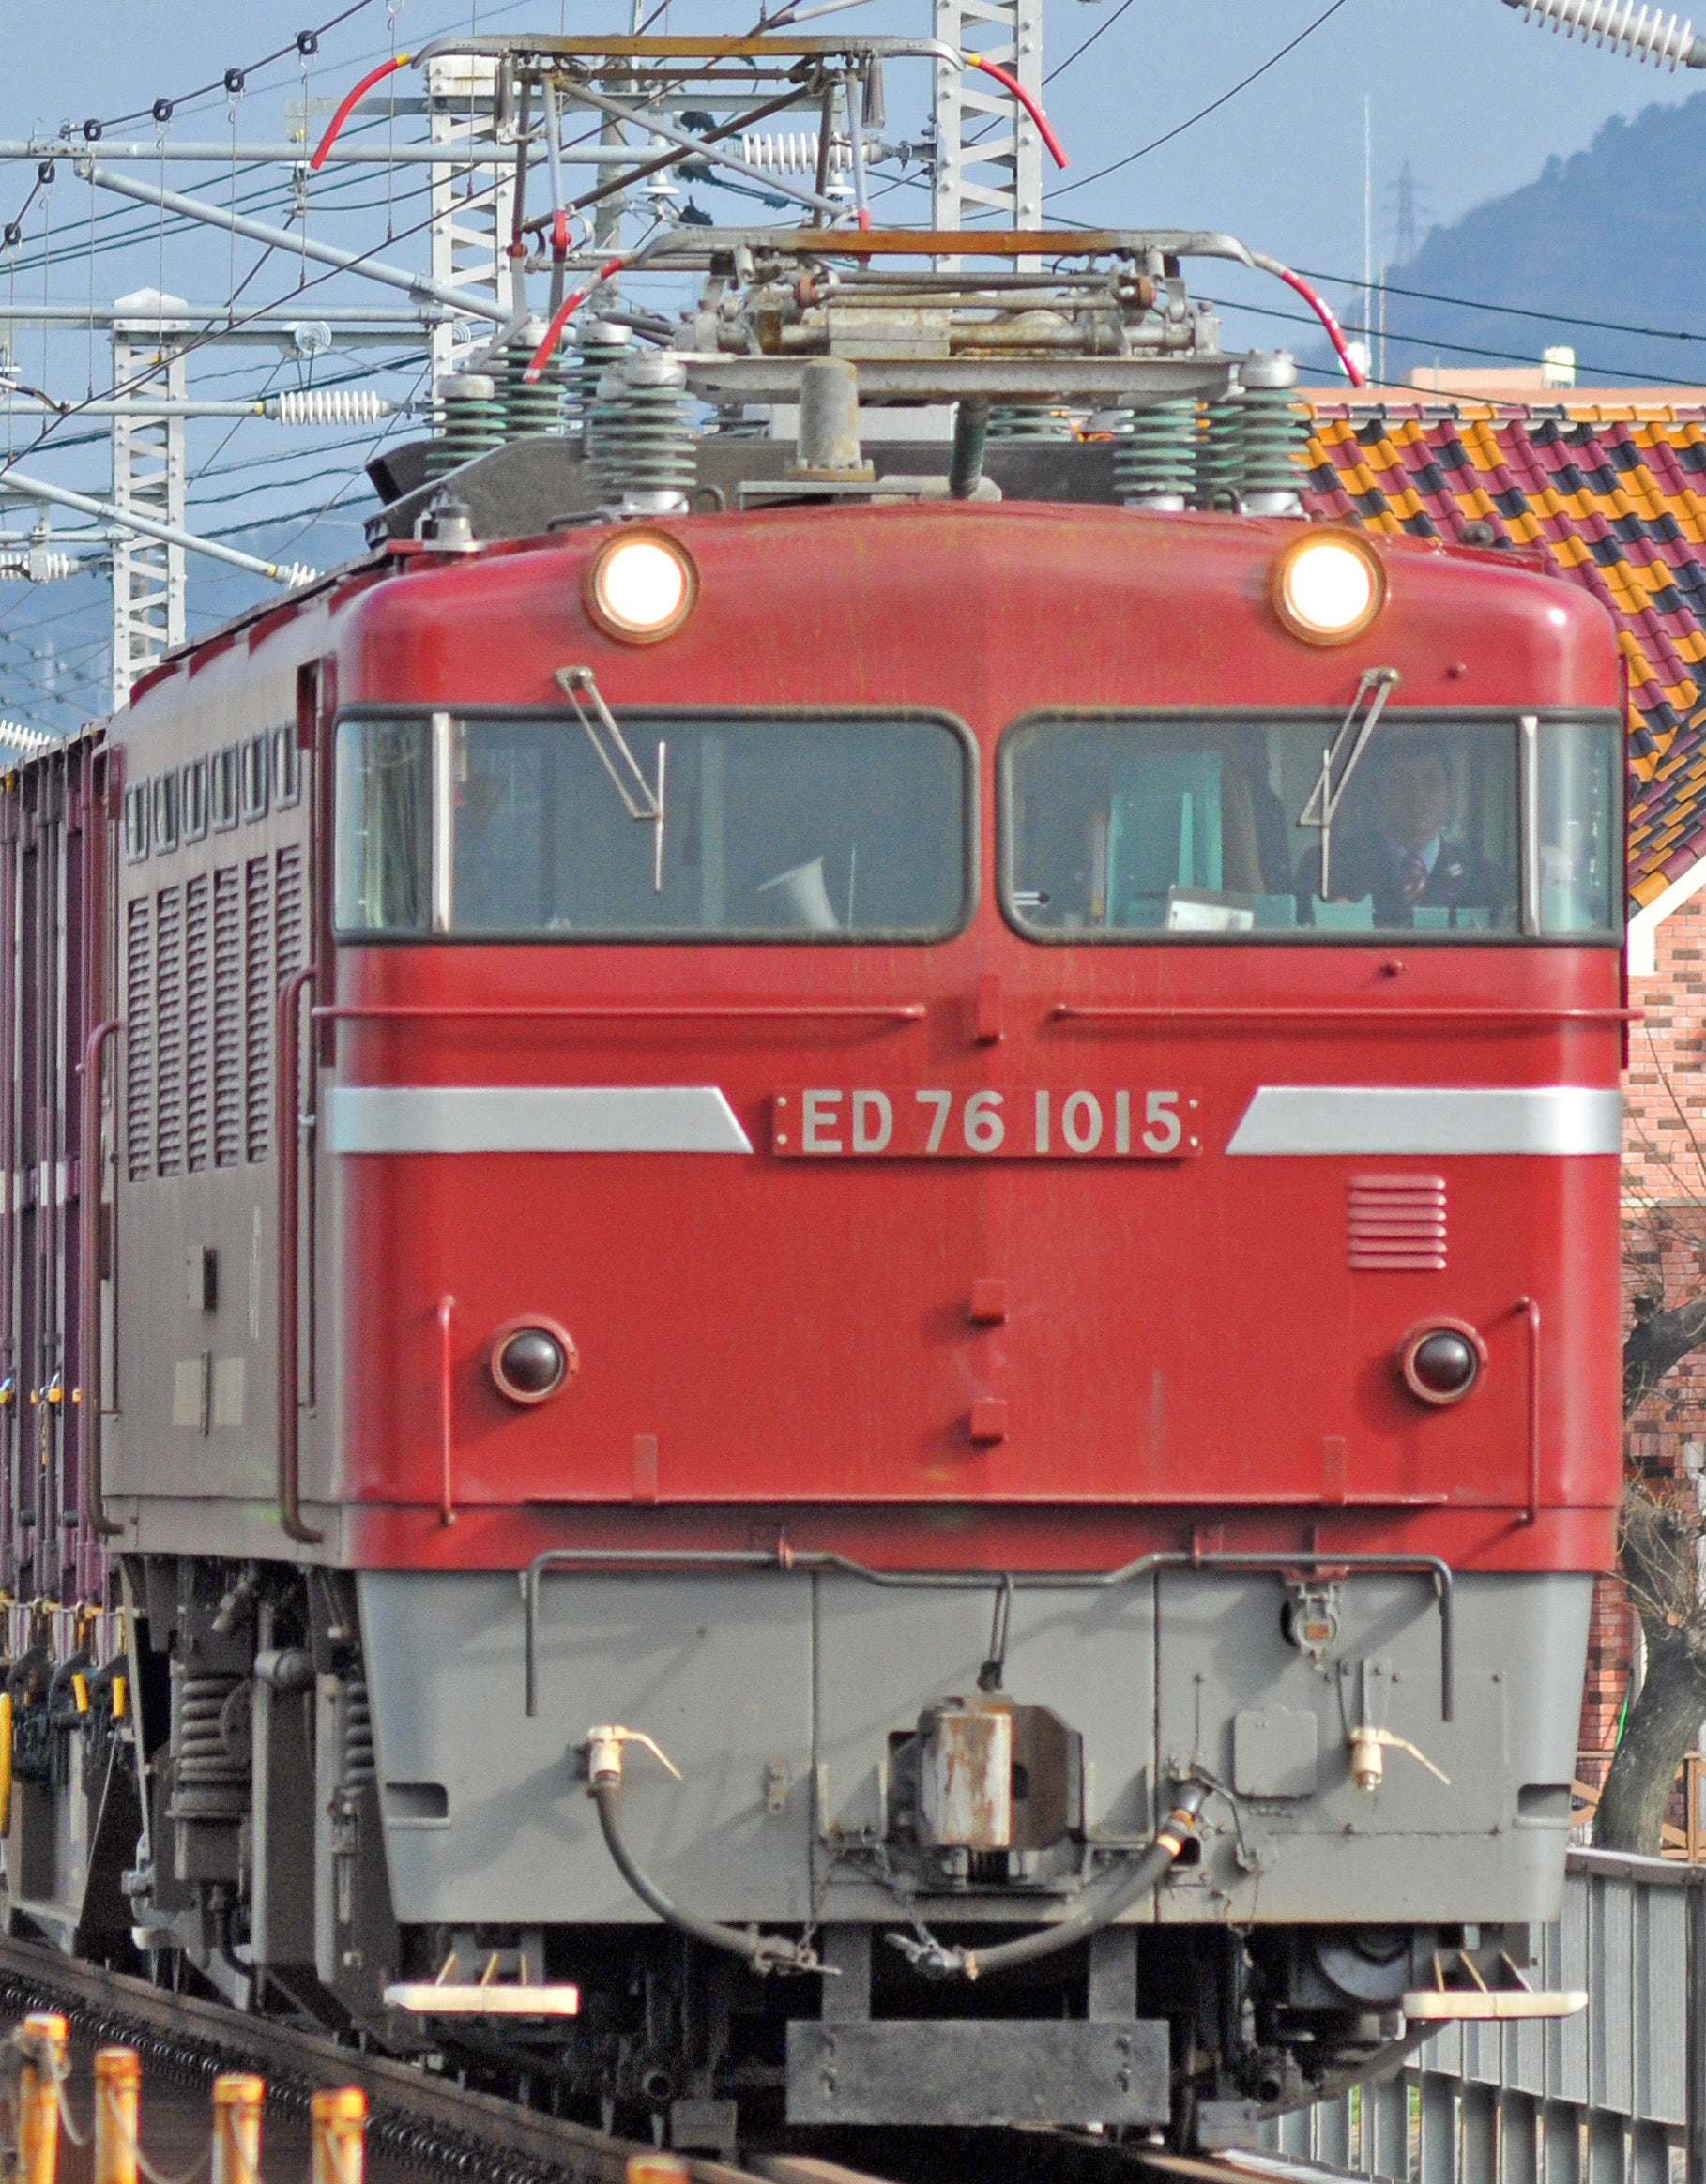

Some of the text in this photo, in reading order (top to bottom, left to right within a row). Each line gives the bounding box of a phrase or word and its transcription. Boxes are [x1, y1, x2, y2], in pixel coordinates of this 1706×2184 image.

[801, 1088, 1182, 1155] ED 76 1015
